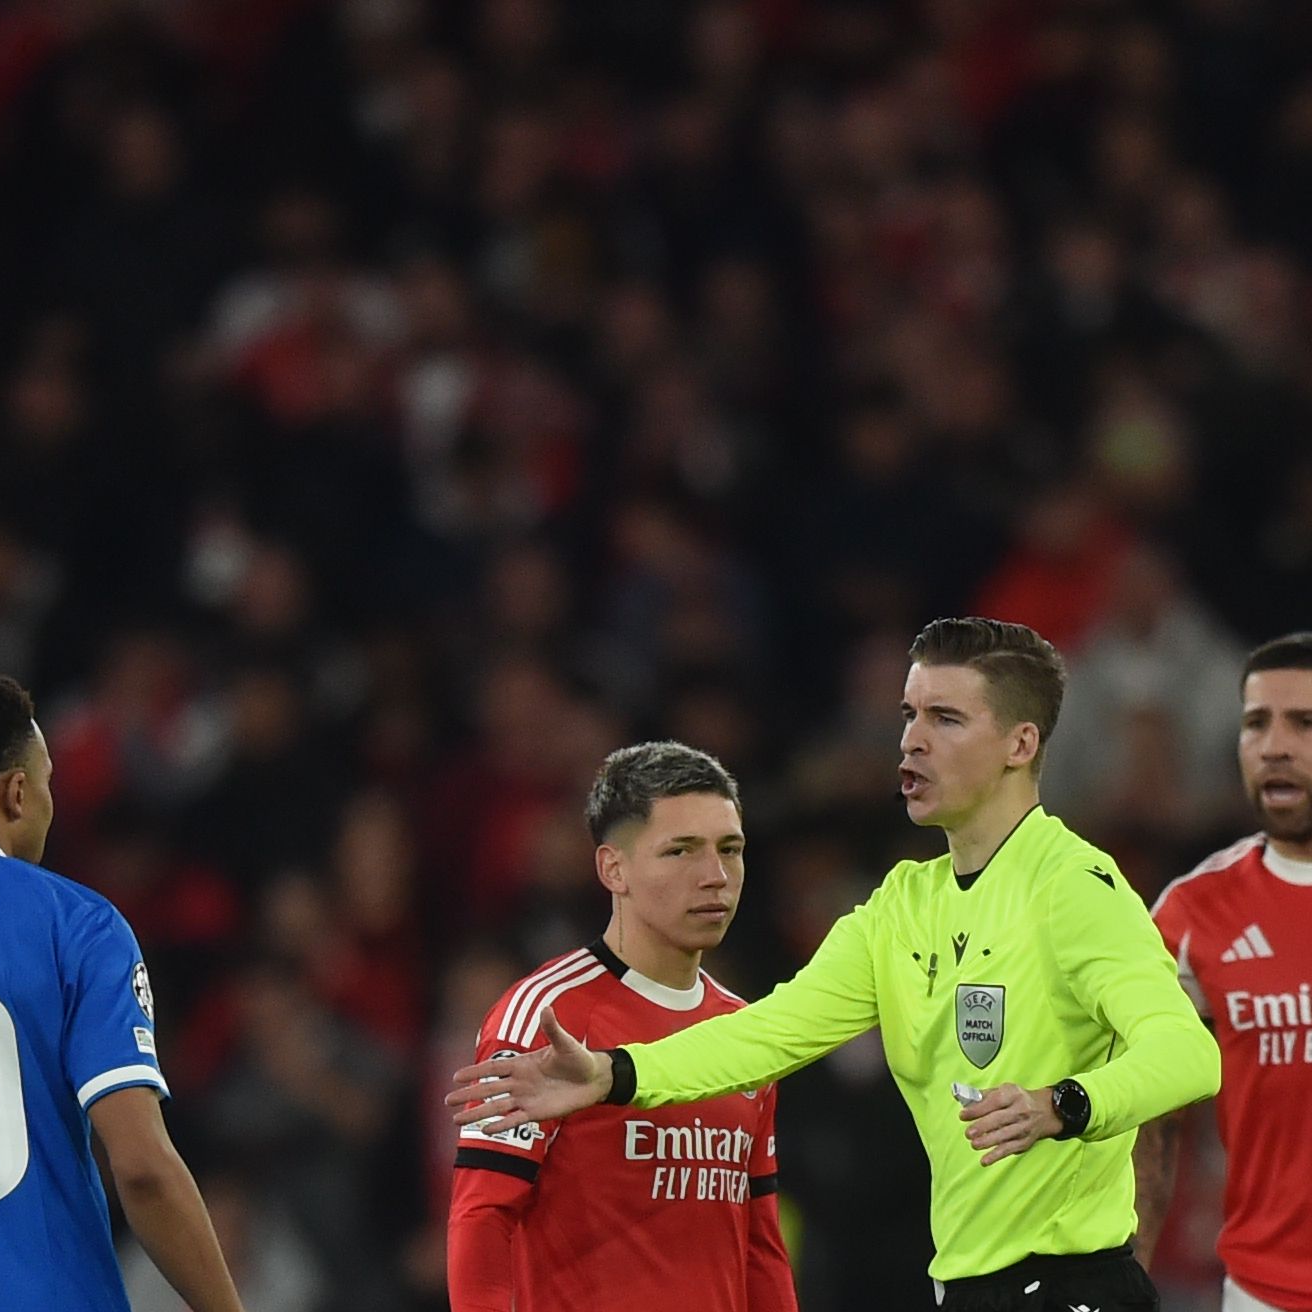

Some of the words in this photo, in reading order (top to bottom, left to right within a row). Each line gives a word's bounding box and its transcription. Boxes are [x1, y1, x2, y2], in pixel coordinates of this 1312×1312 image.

[964, 994, 993, 1010] UEFA
[965, 1019, 993, 1030] MATCH
[961, 1031, 997, 1043] OFFICIAL
[1258, 1031, 1297, 1066] FLY
[651, 1166, 692, 1200] FLY
[696, 1167, 749, 1205] BETTER
